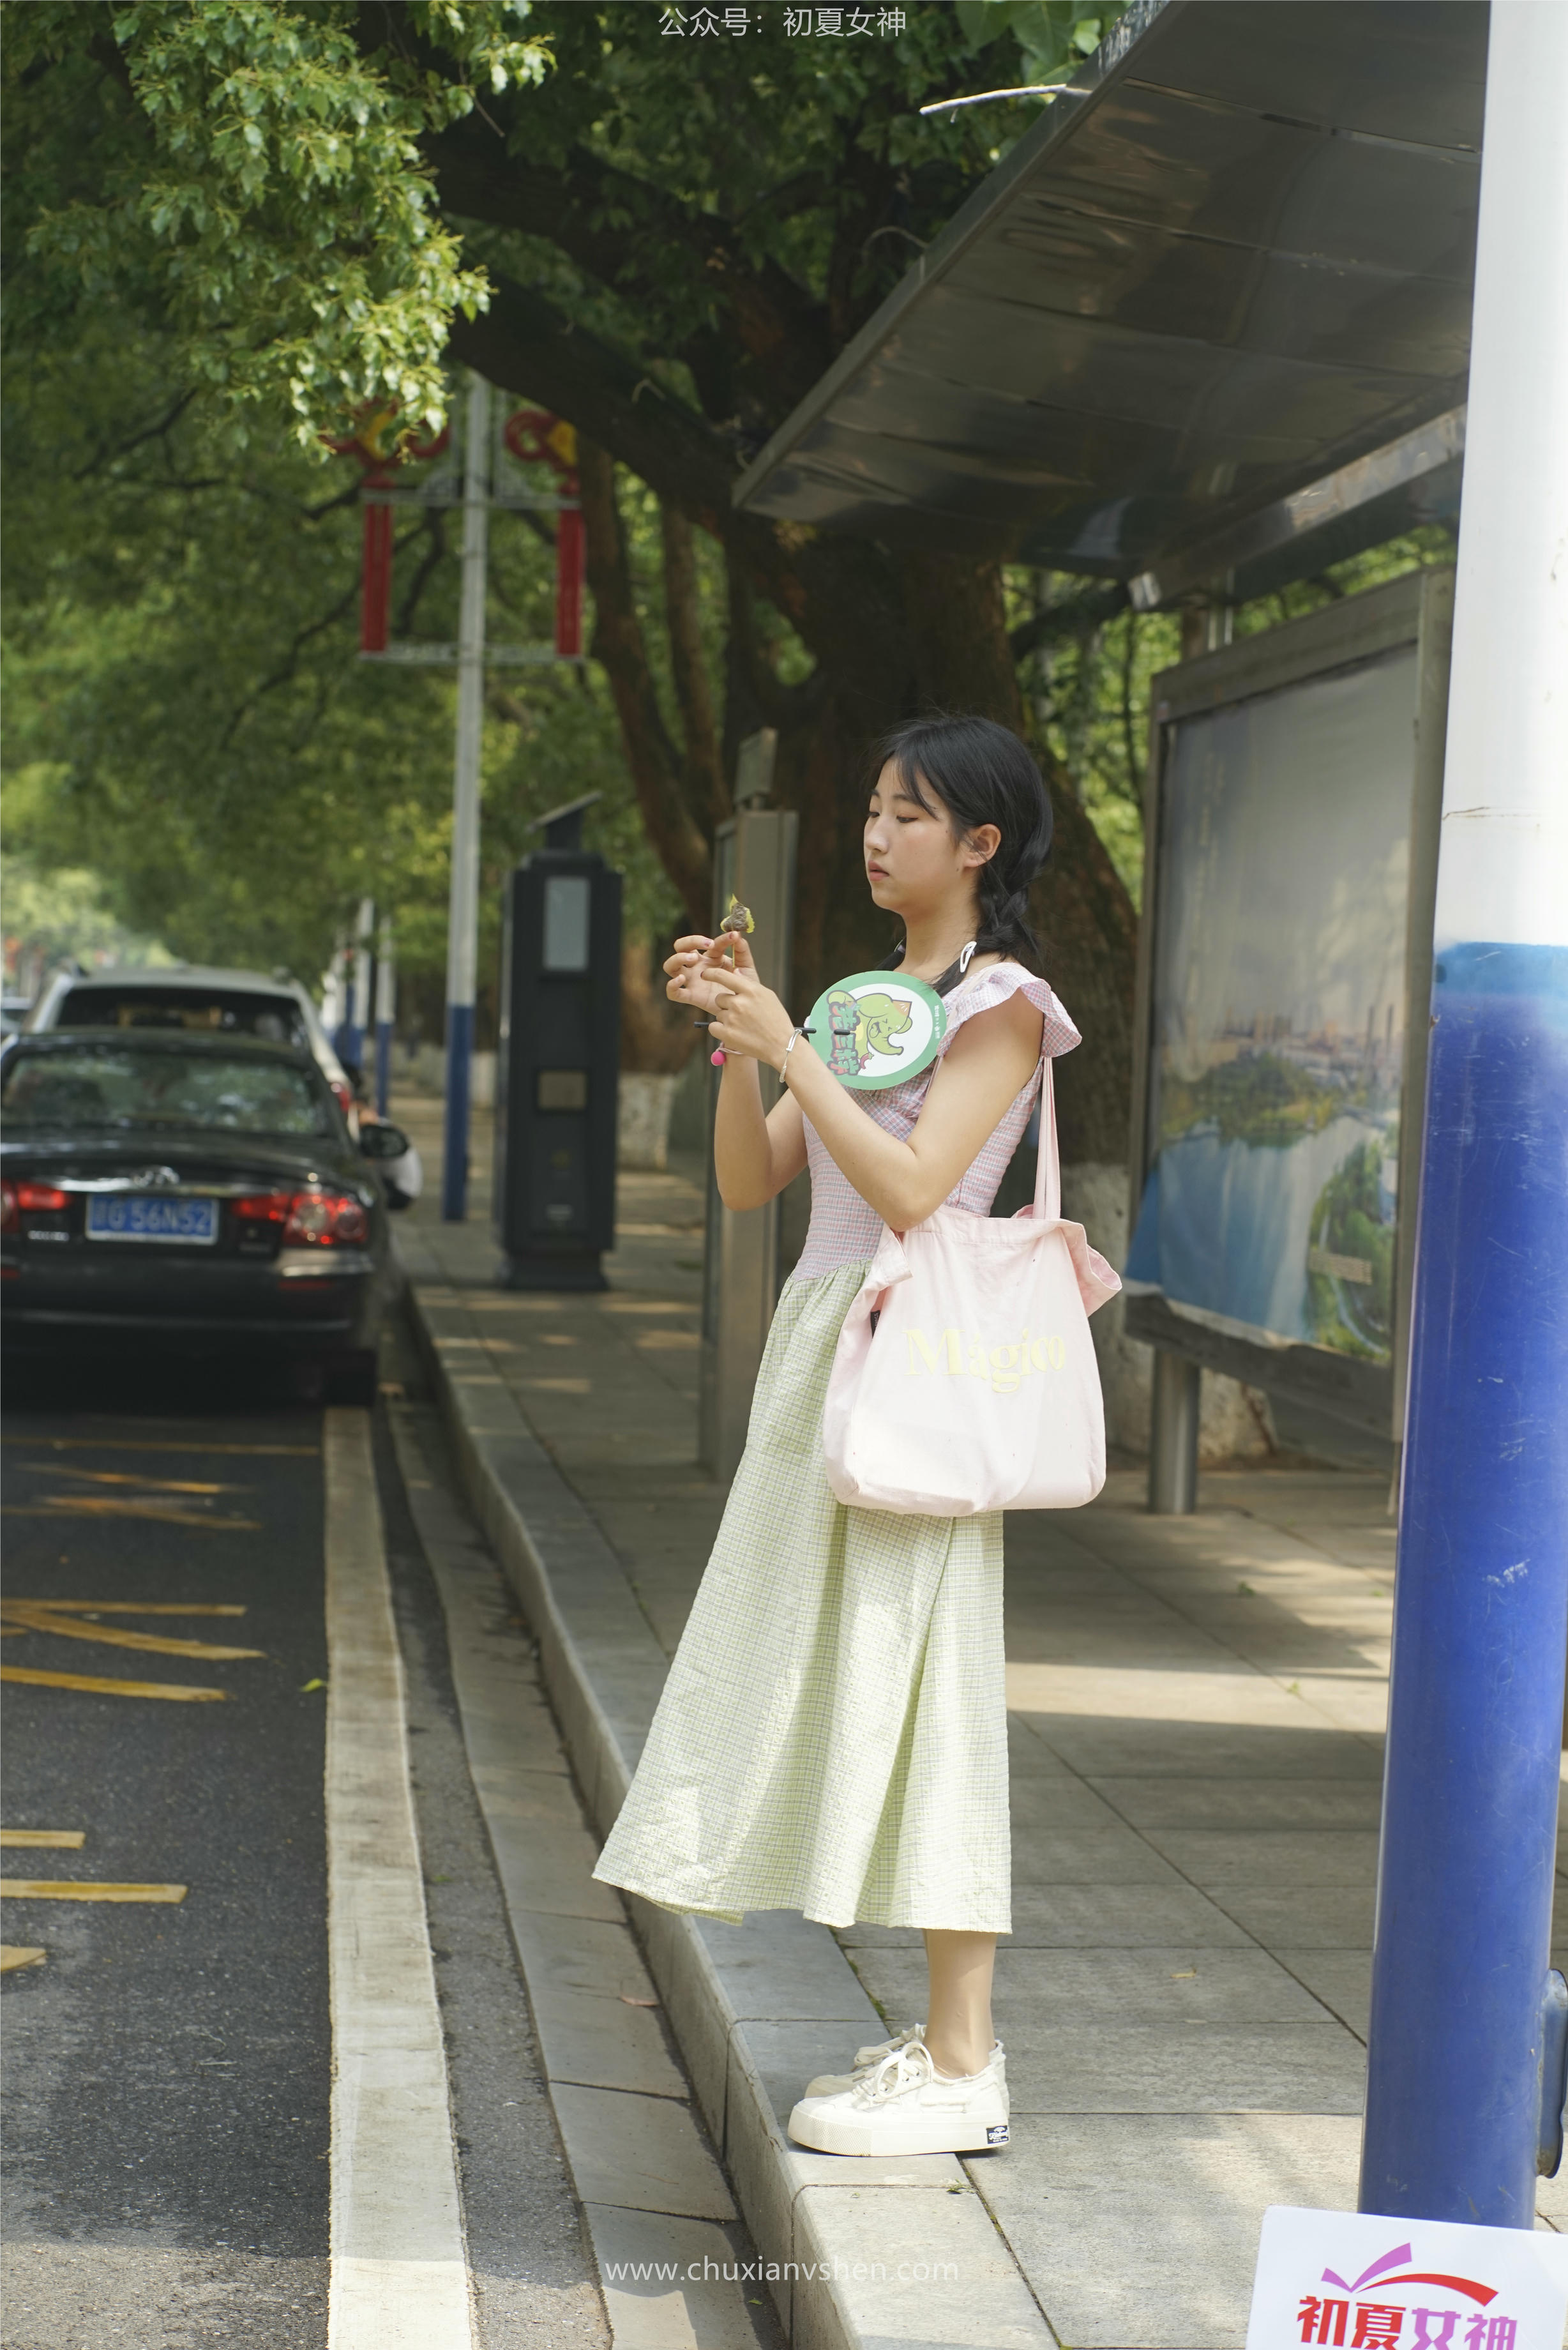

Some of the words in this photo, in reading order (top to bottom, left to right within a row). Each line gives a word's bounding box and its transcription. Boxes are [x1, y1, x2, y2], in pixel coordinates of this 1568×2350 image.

[901, 1328, 1065, 1393] Mágico
[1297, 2295, 1518, 2350] 初夏女神
